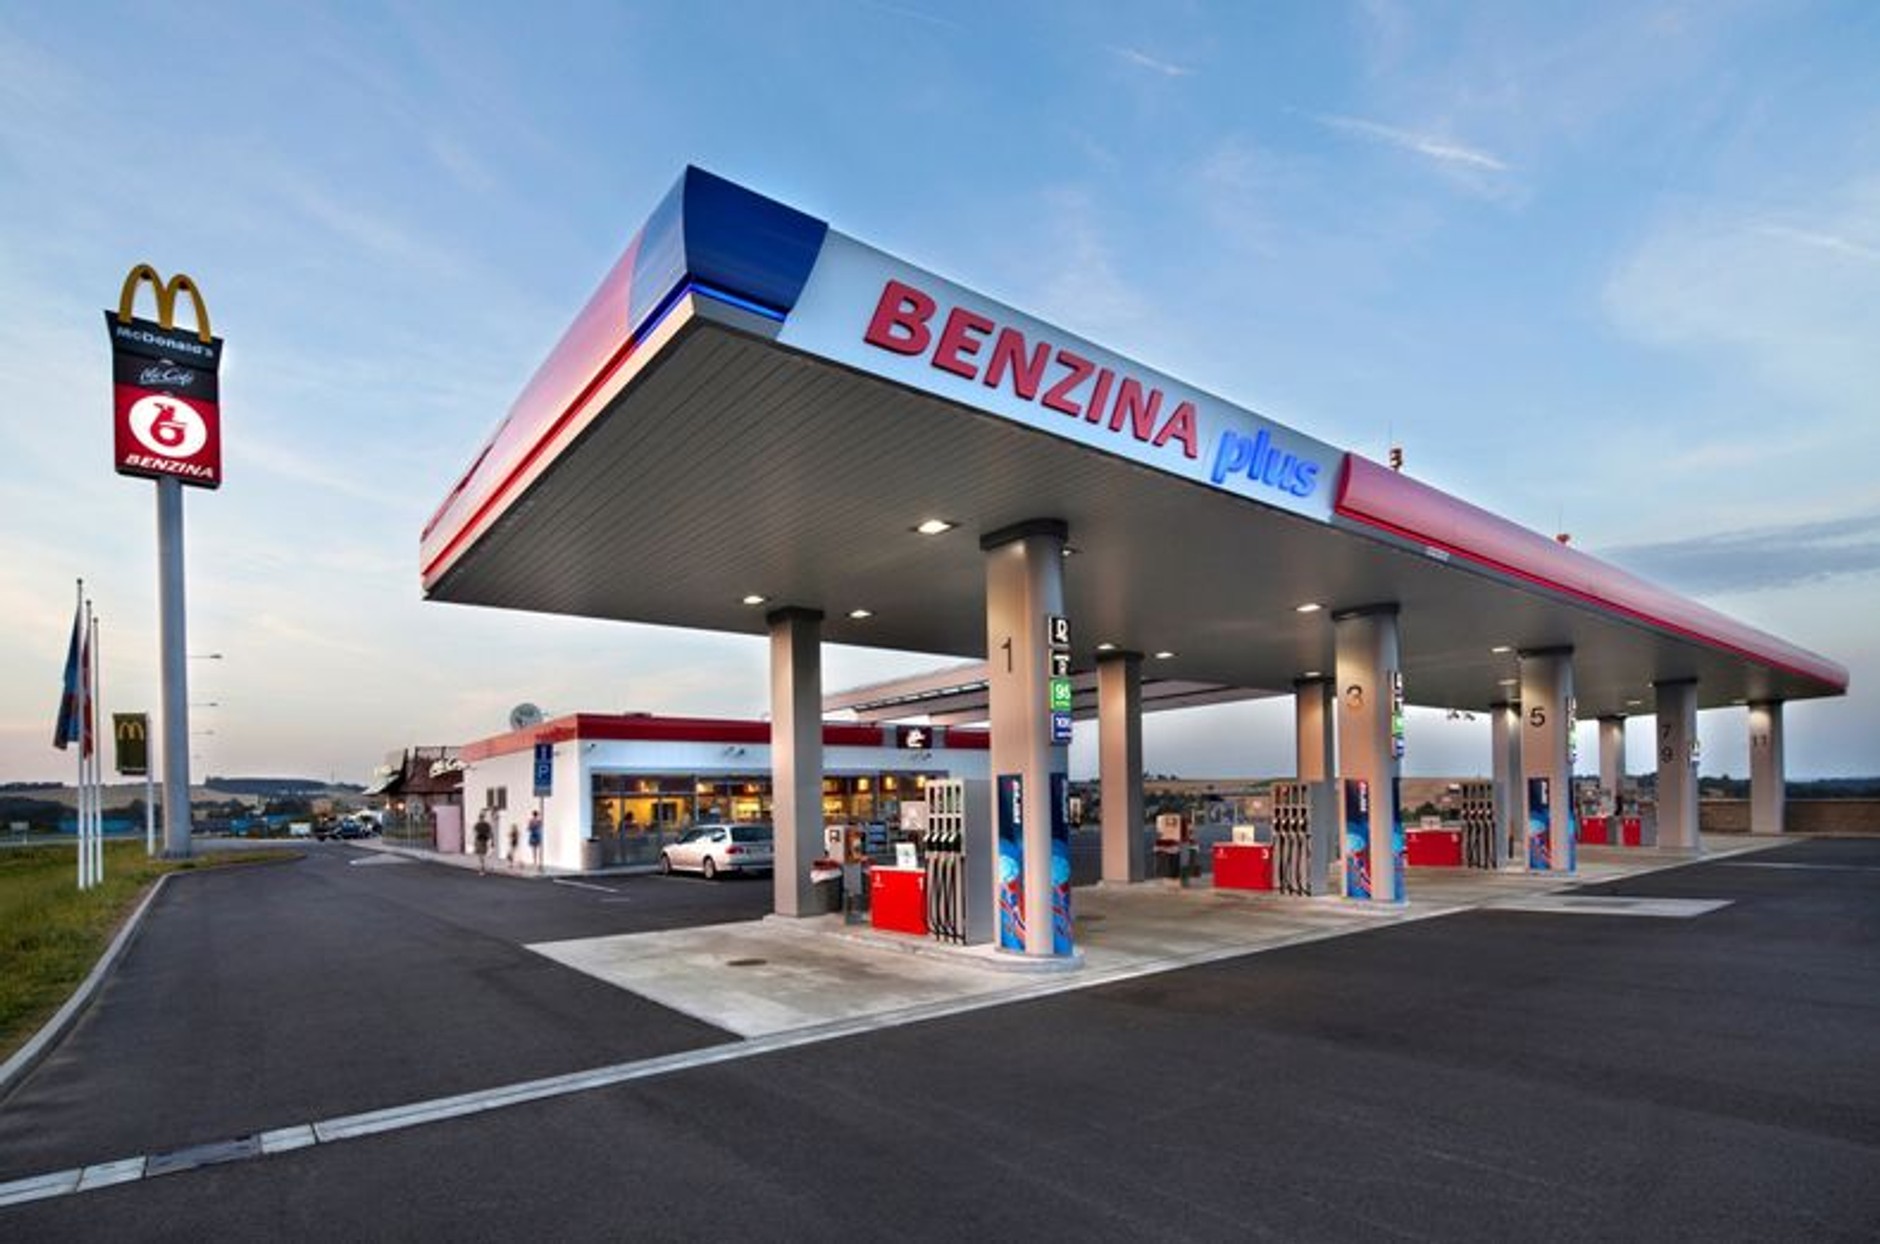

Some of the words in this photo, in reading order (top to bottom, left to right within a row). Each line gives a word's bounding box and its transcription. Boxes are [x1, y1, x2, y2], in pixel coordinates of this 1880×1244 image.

[864, 278, 1199, 460] BENZINA
[1210, 427, 1322, 498] plus
[124, 453, 214, 479] BENZINA
[1000, 636, 1012, 673] 1
[1346, 684, 1364, 708] 3
[1530, 706, 1546, 728] 5
